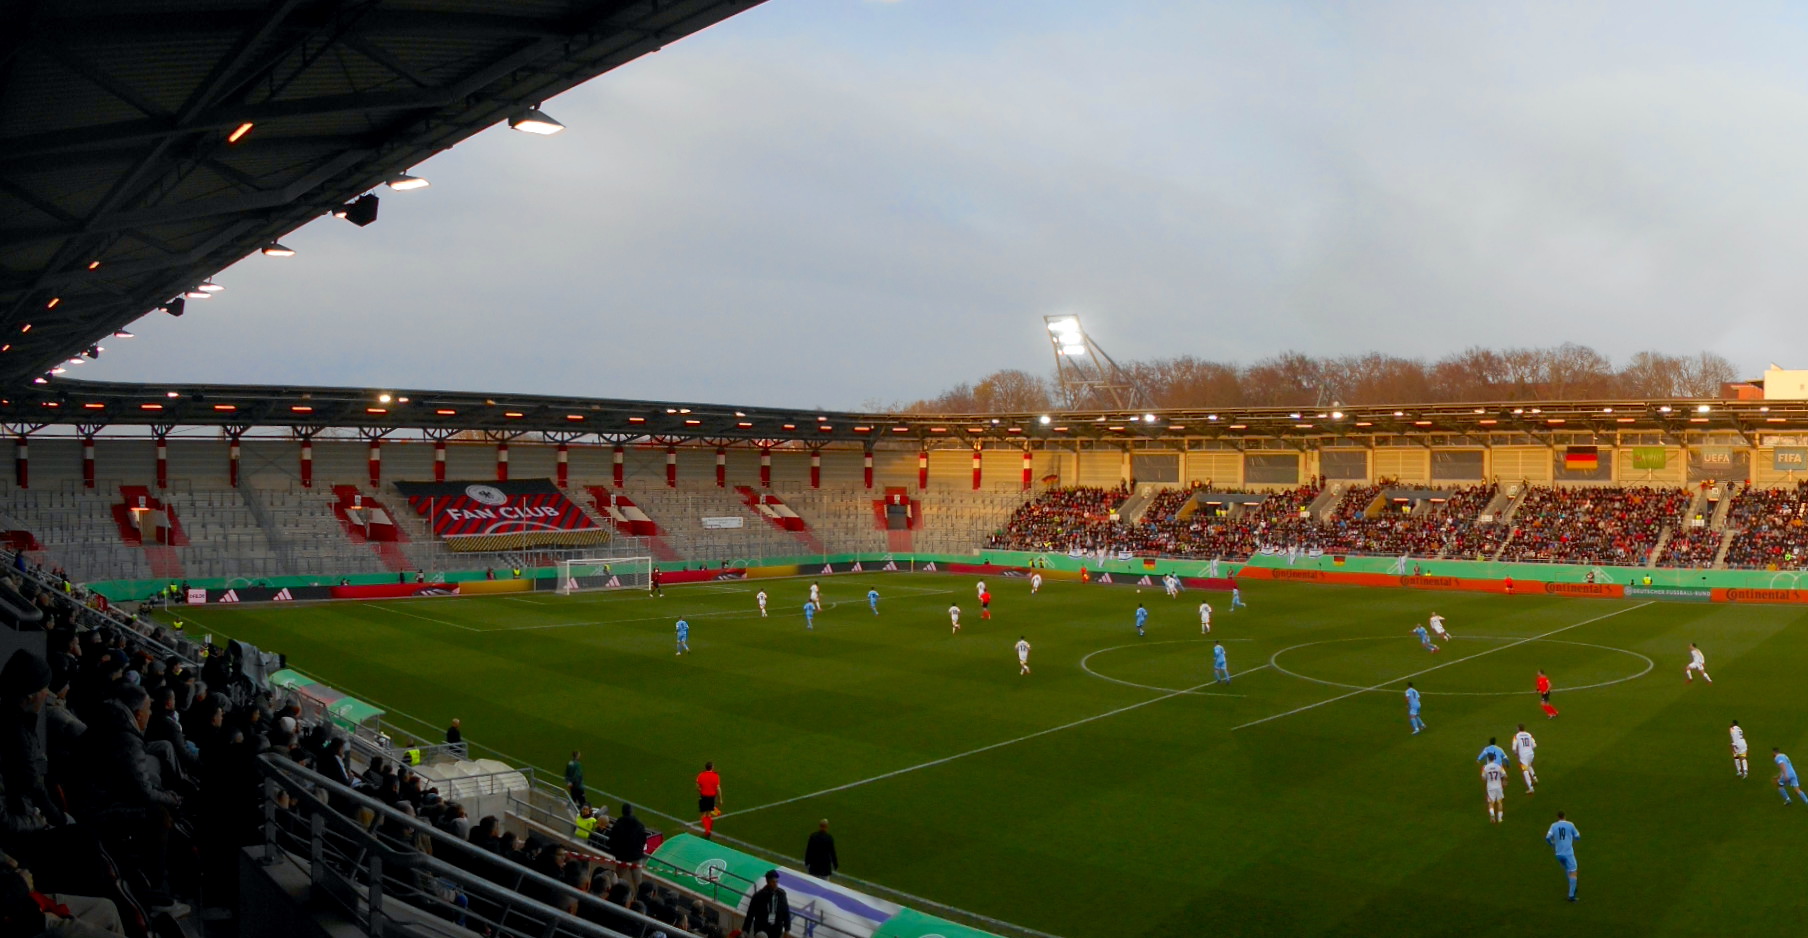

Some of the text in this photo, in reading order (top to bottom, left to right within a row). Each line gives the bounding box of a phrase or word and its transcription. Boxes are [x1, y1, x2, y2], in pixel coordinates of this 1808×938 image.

[1704, 454, 1731, 463] UEFA
[1778, 453, 1802, 463] FIFA
[446, 506, 560, 521] FAN CLUB
[1400, 575, 1452, 587] Continental
[1545, 581, 1603, 593] Continental
[1726, 587, 1790, 601] Continental
[1521, 737, 1530, 747] 10
[1488, 771, 1499, 781] 17
[1558, 827, 1566, 841] 19
